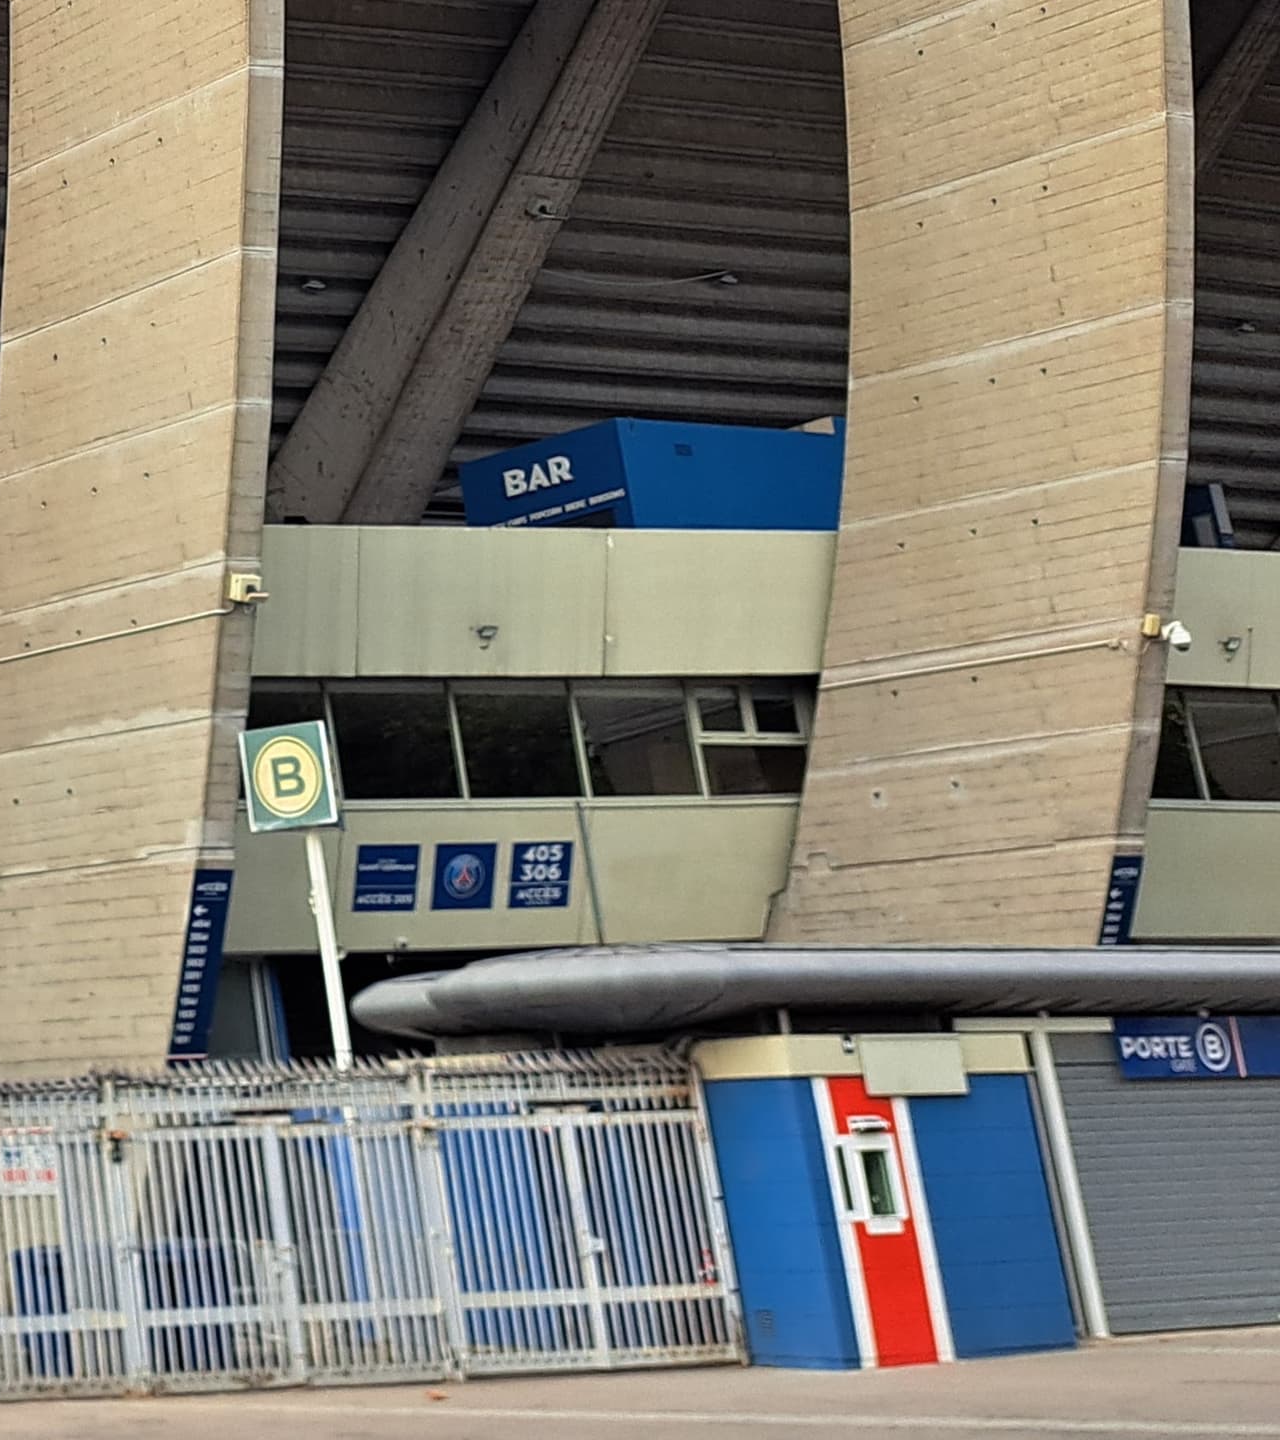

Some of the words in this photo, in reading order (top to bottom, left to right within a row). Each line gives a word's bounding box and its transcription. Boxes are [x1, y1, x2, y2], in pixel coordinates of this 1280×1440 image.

[502, 455, 574, 498] BAR
[271, 755, 306, 798] B
[523, 844, 563, 862] 405
[519, 863, 562, 881] 306
[1119, 1035, 1194, 1059] PORTE
[1203, 1033, 1224, 1060] B
